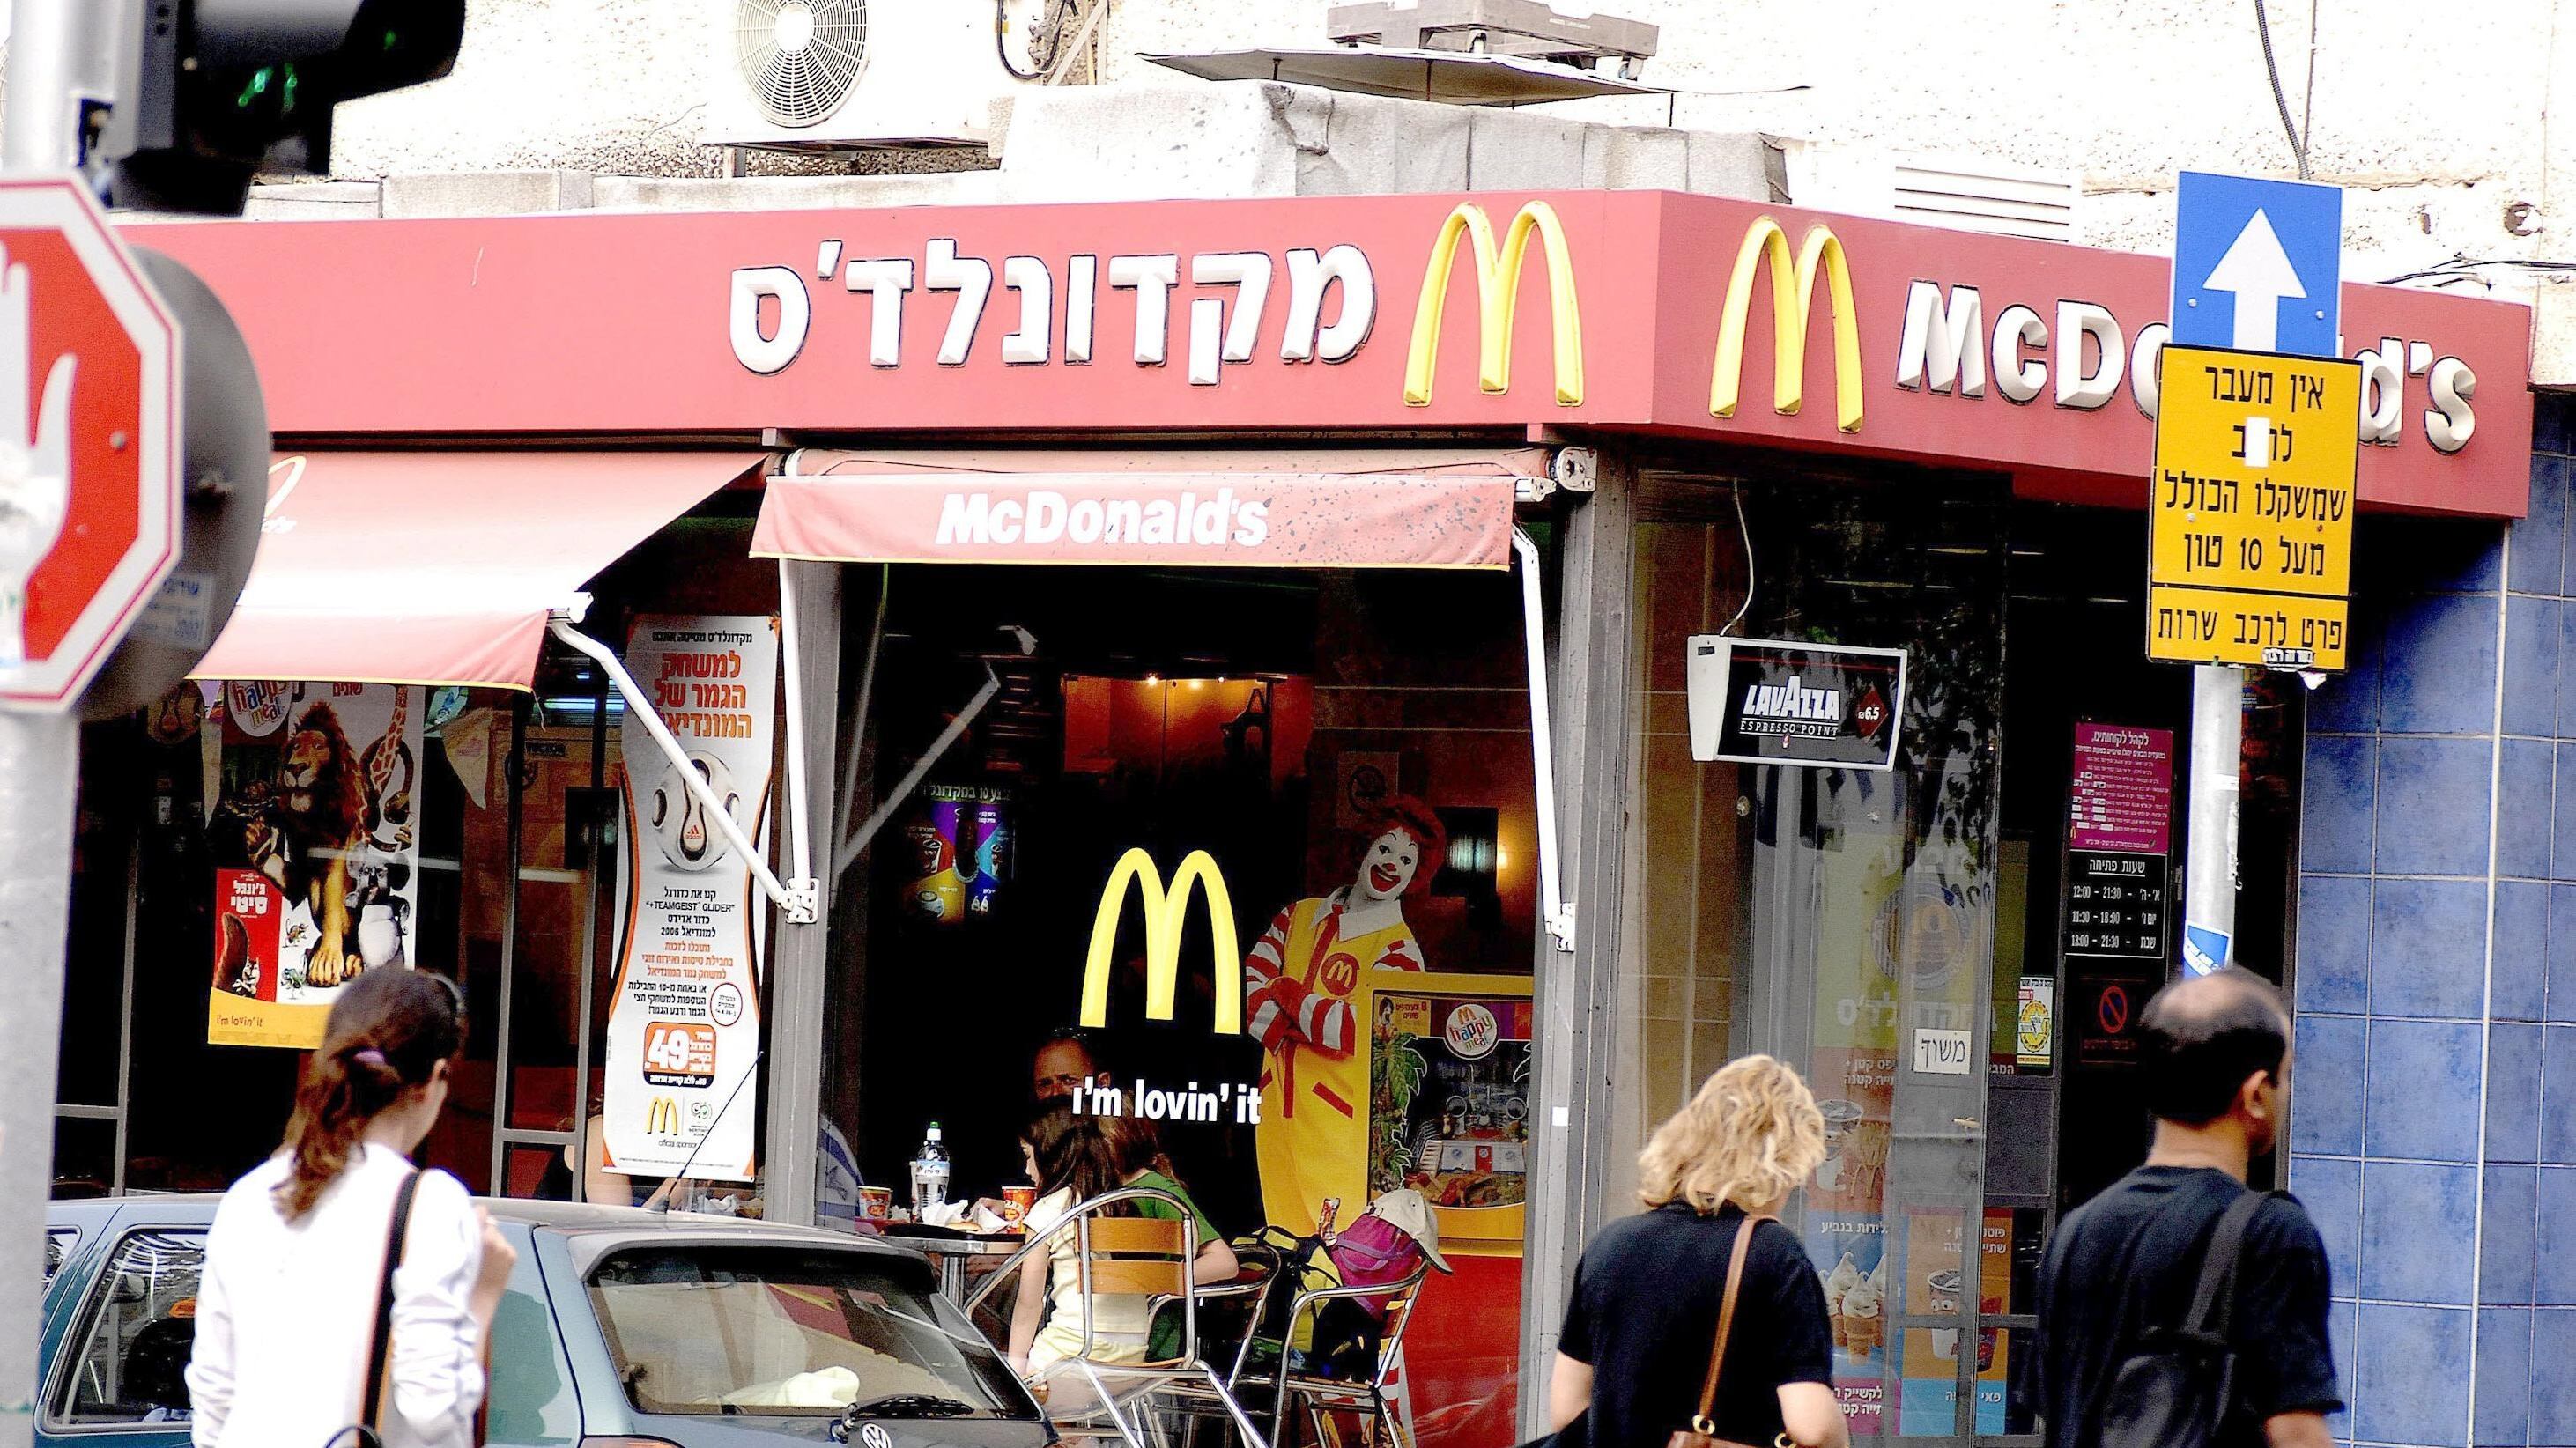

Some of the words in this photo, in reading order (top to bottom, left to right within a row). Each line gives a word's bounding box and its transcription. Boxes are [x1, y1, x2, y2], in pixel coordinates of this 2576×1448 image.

[729, 237, 1378, 388] מקדונלד'ס
[1894, 277, 2478, 456] McDod's
[2205, 366, 2274, 404] מעבר
[2291, 374, 2324, 413] אין
[2232, 424, 2293, 462] לרב
[2165, 469, 2239, 513] הכולל
[2255, 478, 2347, 522] שמשקלו
[935, 487, 1269, 546] McDonald's
[2185, 534, 2223, 572] טון
[2240, 538, 2262, 571] 10
[2280, 535, 2325, 576] מעל
[2158, 609, 2218, 641] שרות
[2233, 611, 2287, 646] לרכב
[2302, 618, 2342, 650] פרט
[662, 650, 741, 681] למשחק
[654, 678, 686, 707] של
[691, 683, 747, 709] הגמר
[1743, 676, 1840, 720] LAVAZZA
[1740, 720, 1795, 733] ESPRESSO
[1800, 724, 1839, 736] POINT
[2090, 859, 2117, 871] פתיחה
[2121, 861, 2145, 874] שעות
[1449, 1015, 1493, 1042] happy
[1921, 1038, 1965, 1068] משוך
[1072, 1076, 1121, 1117] i'm
[1135, 1079, 1230, 1121] lovin'
[1236, 1083, 1262, 1125] it
